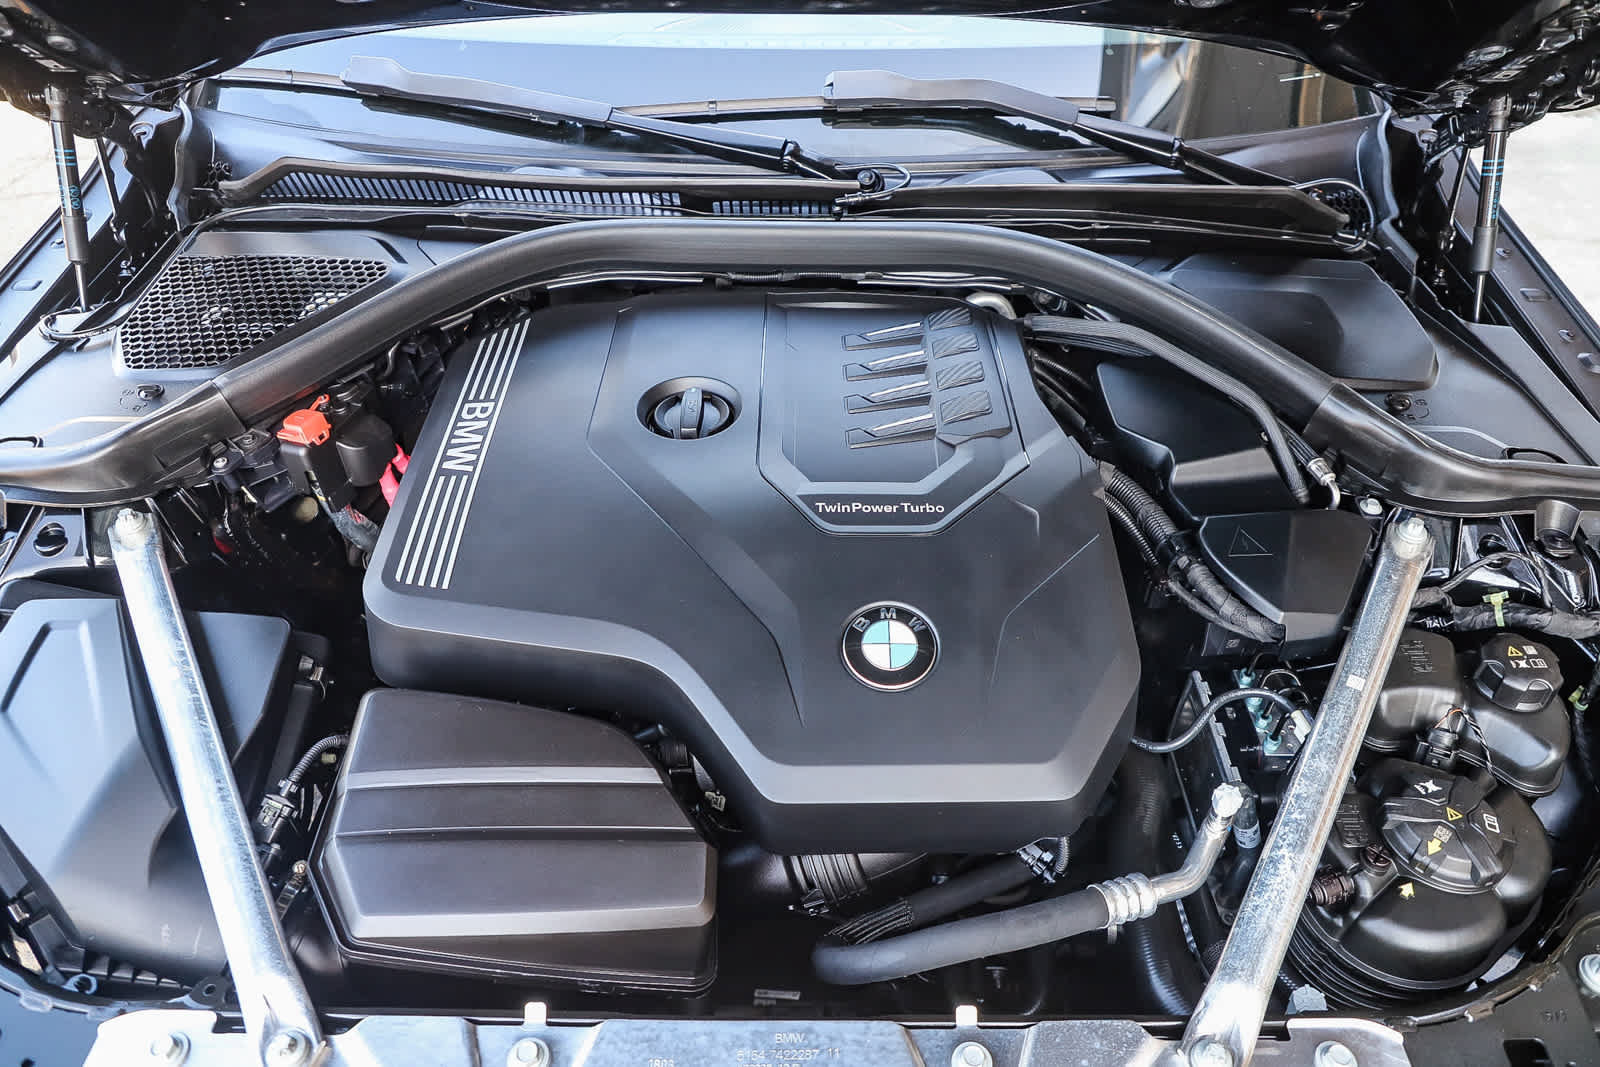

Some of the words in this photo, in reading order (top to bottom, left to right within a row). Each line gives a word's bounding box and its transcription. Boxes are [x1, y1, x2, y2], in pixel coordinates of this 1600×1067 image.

[441, 401, 496, 472] BMW
[815, 502, 899, 513] TwinPower
[900, 502, 945, 513] Turbo
[852, 607, 926, 633] BMW
[775, 1033, 806, 1044] BMW
